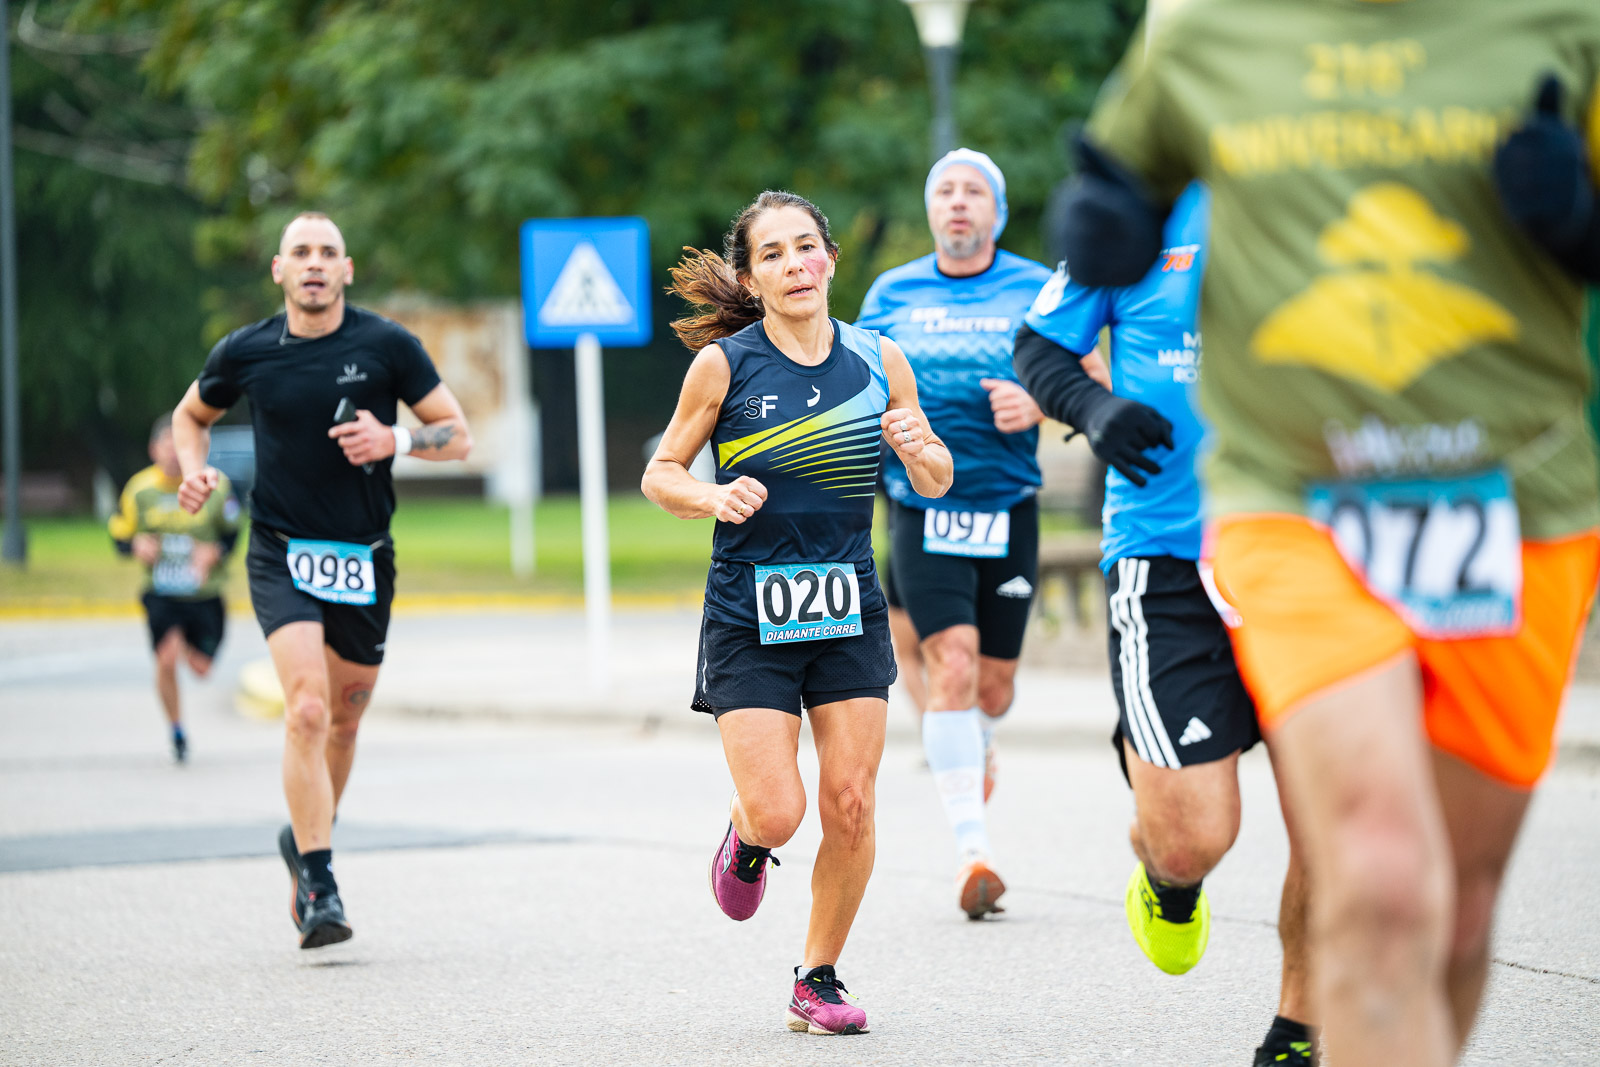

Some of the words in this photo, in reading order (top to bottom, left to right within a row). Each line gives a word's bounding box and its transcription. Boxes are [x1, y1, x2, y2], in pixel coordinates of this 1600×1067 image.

[744, 395, 778, 419] SF
[934, 510, 998, 542] 097
[295, 551, 364, 591] 098
[763, 566, 852, 627] 020
[765, 627, 821, 642] DIAMANTE
[823, 624, 857, 636] CORRE
